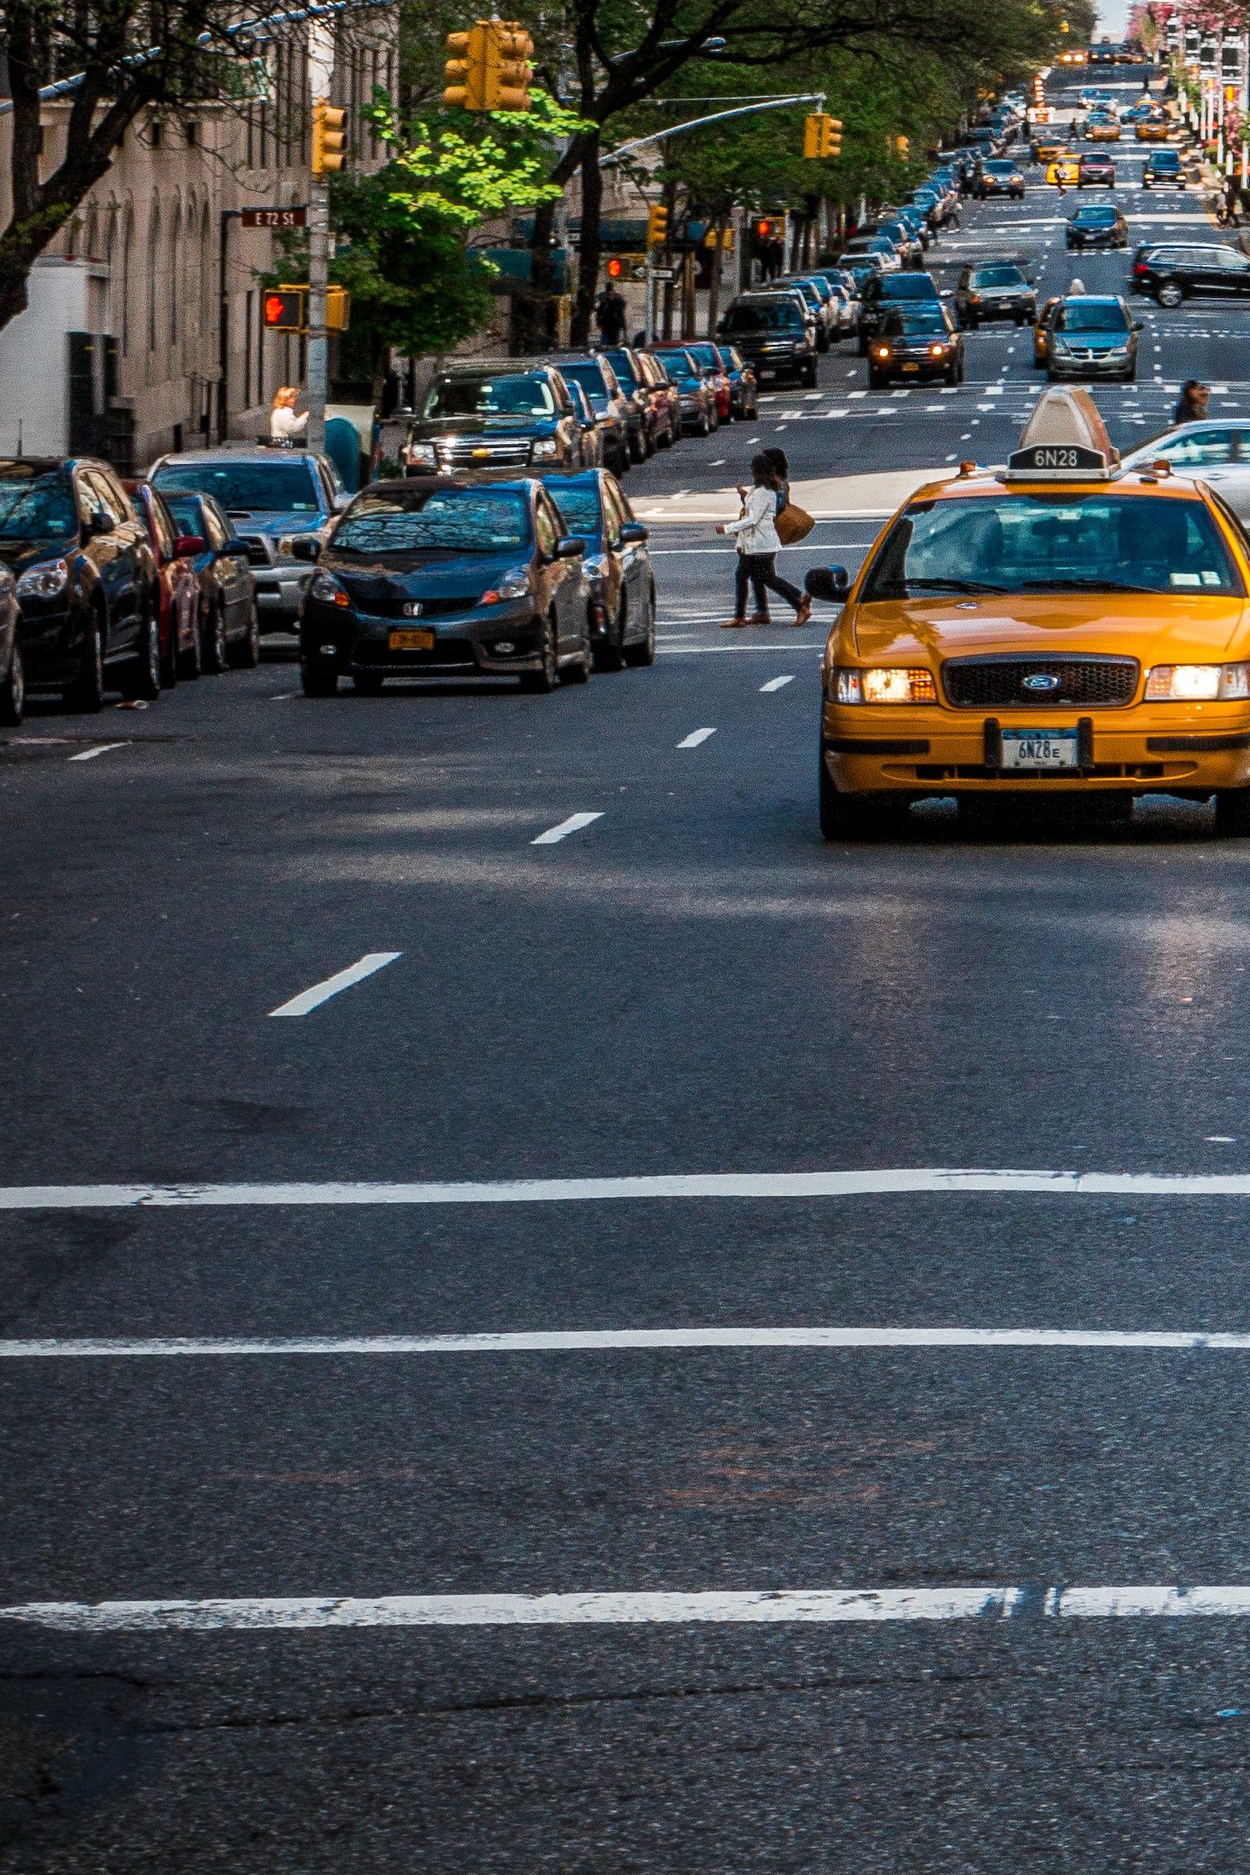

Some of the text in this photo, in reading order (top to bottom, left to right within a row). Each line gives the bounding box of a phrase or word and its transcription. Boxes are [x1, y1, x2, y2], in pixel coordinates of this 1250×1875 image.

[255, 212, 294, 225] E 72 St
[1034, 450, 1077, 466] 6N28
